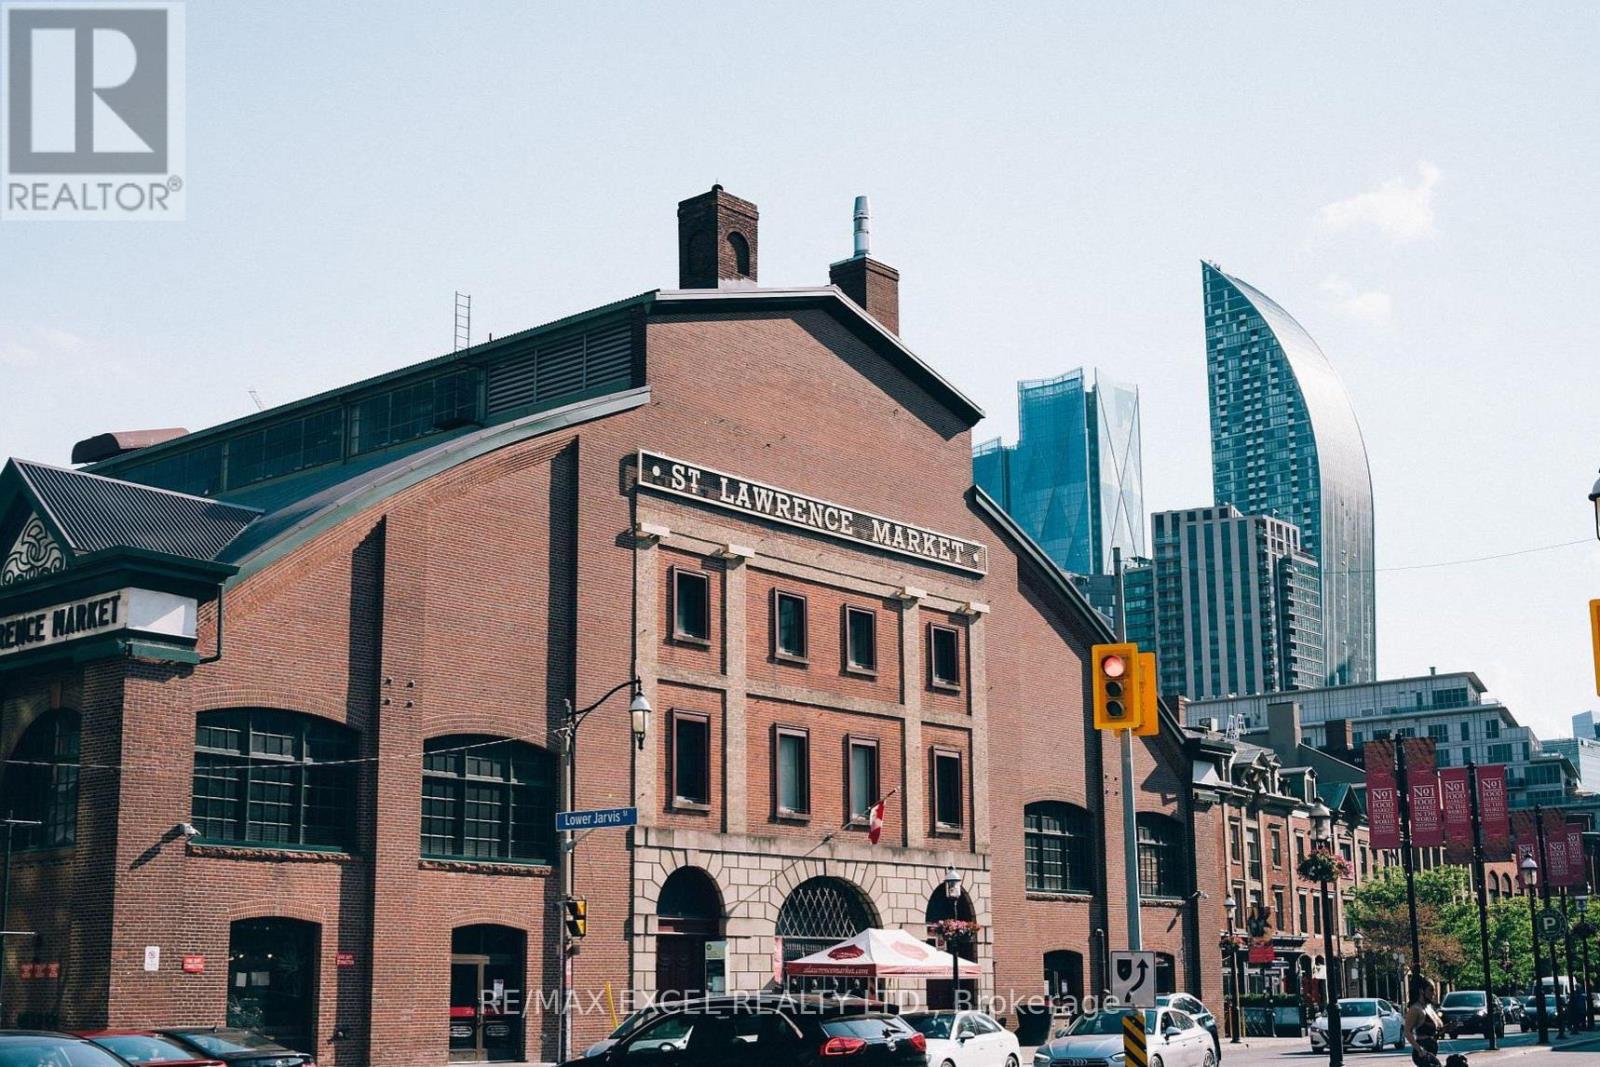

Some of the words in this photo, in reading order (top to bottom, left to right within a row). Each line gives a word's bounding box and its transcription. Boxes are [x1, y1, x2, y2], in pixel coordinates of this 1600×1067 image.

[719, 477, 853, 535] LAWRENCE
[871, 519, 964, 564] MARKET
[51, 594, 121, 638] MARKET
[564, 814, 592, 826] Lower
[593, 811, 621, 824] Jarvis
[1543, 917, 1556, 930] P
